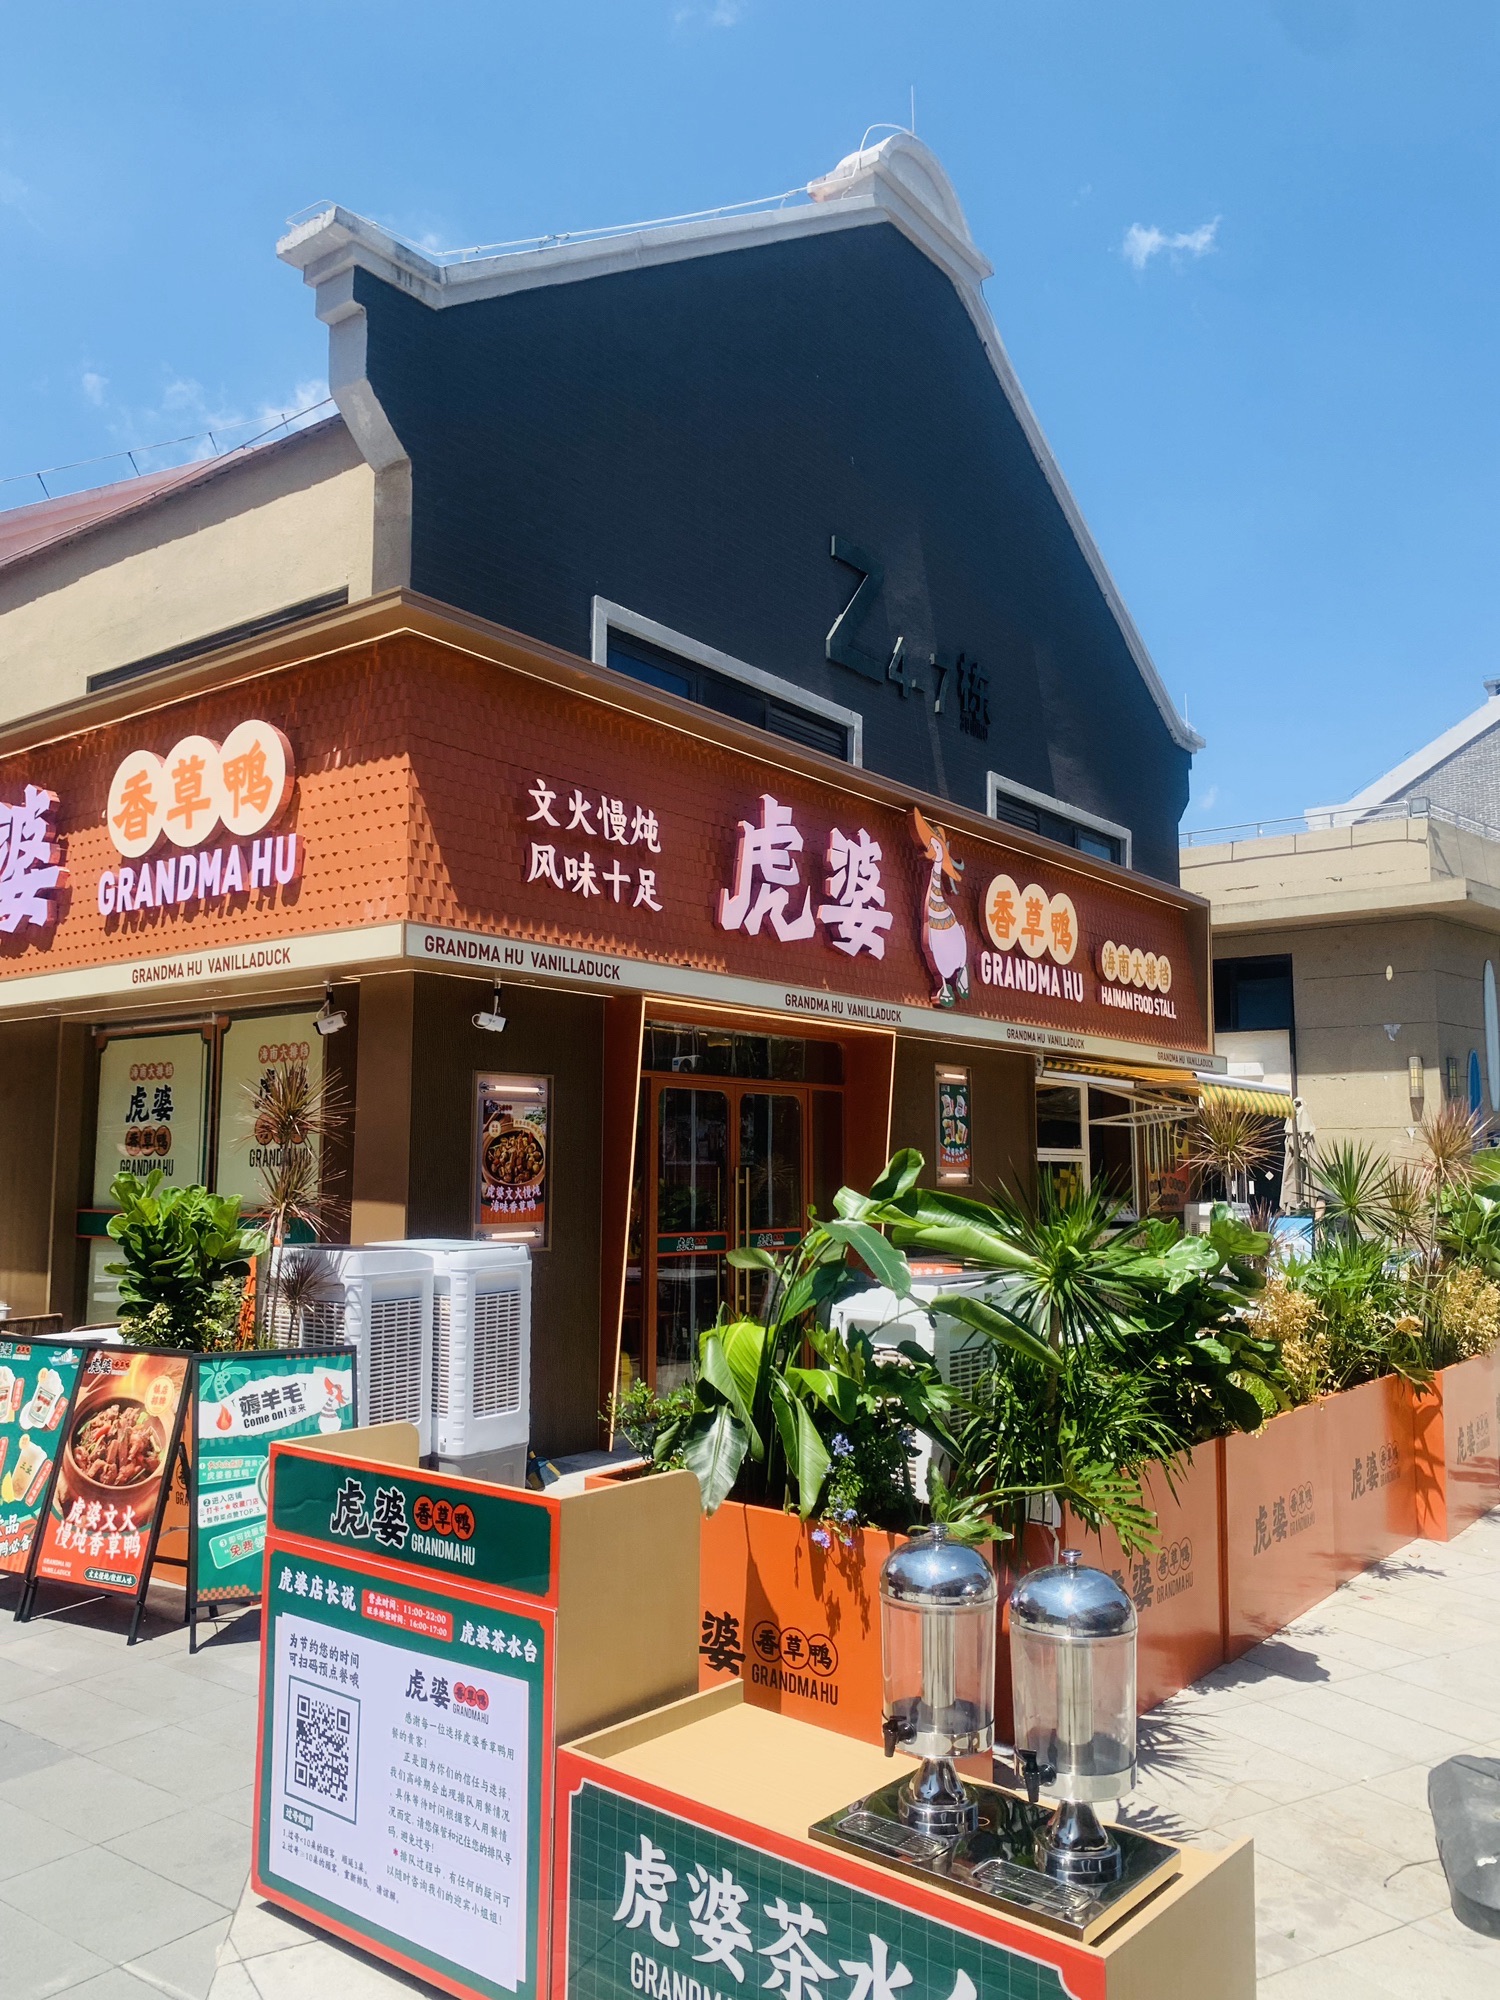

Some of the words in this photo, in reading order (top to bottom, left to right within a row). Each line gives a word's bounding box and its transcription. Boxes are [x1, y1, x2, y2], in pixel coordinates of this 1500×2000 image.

[111, 738, 274, 842] 香草鸭
[525, 778, 662, 854] 文火慢炖
[97, 852, 244, 916] GRANDMA
[250, 833, 298, 890] HU
[526, 842, 664, 912] 风味十足
[719, 793, 894, 961] 虎婆
[988, 889, 1073, 956] 香草鸭
[131, 963, 184, 985] GRANDMA
[186, 959, 203, 976] HU
[207, 947, 291, 974] VANILLADUCK
[424, 934, 500, 963] GRANDMA
[504, 947, 524, 966] HU
[530, 952, 620, 981] VANILLADUCK
[980, 950, 1061, 999] GRANDMA
[1062, 972, 1084, 1003] HU
[1102, 946, 1171, 990] 海南大排档
[784, 993, 830, 1013] GRANDMA
[831, 1000, 844, 1014] HU
[846, 1003, 902, 1023] VANILLADUCK
[1101, 985, 1133, 1012] HAINAN
[1133, 994, 1154, 1015] FOOD
[1154, 998, 1177, 1020] STALL
[1006, 1028, 1036, 1043] GRANDMA
[1037, 1031, 1046, 1044] HU
[1047, 1034, 1085, 1050] VANILLADUCK
[125, 1085, 174, 1122] 虎婆
[486, 1183, 542, 1201] 虎婆文火慢炖
[490, 1199, 537, 1214] 海味香草鸭
[239, 1382, 303, 1418] 薅羊毛
[243, 1414, 270, 1429] Come
[271, 1408, 288, 1422] on!
[1352, 1451, 1379, 1501] 虎婆
[66, 1496, 137, 1532] 虎婆文火
[330, 1476, 410, 1549] 虎婆
[416, 1502, 471, 1536] 香草鸭
[1253, 1495, 1289, 1557] 虎婆
[54, 1520, 141, 1560] 慢炖香草鸭
[411, 1533, 461, 1563] GRANDMA
[461, 1544, 476, 1567] HU
[1157, 1541, 1190, 1576] 香草鸭
[278, 1566, 357, 1612] 虎婆店长说
[1111, 1553, 1155, 1613] 婆
[289, 1632, 360, 1670] 为节约您的时间
[459, 1620, 538, 1664] 虎婆茶水台
[755, 1629, 833, 1670] 香草鸭
[288, 1651, 360, 1690] 可扫码预点餐哦
[405, 1668, 451, 1711] 虎婆
[752, 1663, 818, 1701] GRANDMA
[820, 1681, 839, 1706] HU
[452, 1703, 481, 1723] GRANDMA
[481, 1713, 490, 1725] HU
[454, 1685, 488, 1709] 香草鸭
[404, 1711, 515, 1761] 感谢每一位选择虎婆香草鸭用
[390, 1766, 511, 1823] 我们高峰期会出现排队用餐情况
[613, 1834, 978, 2000] 虎婆茶水
[631, 1952, 733, 2000] GRAND
